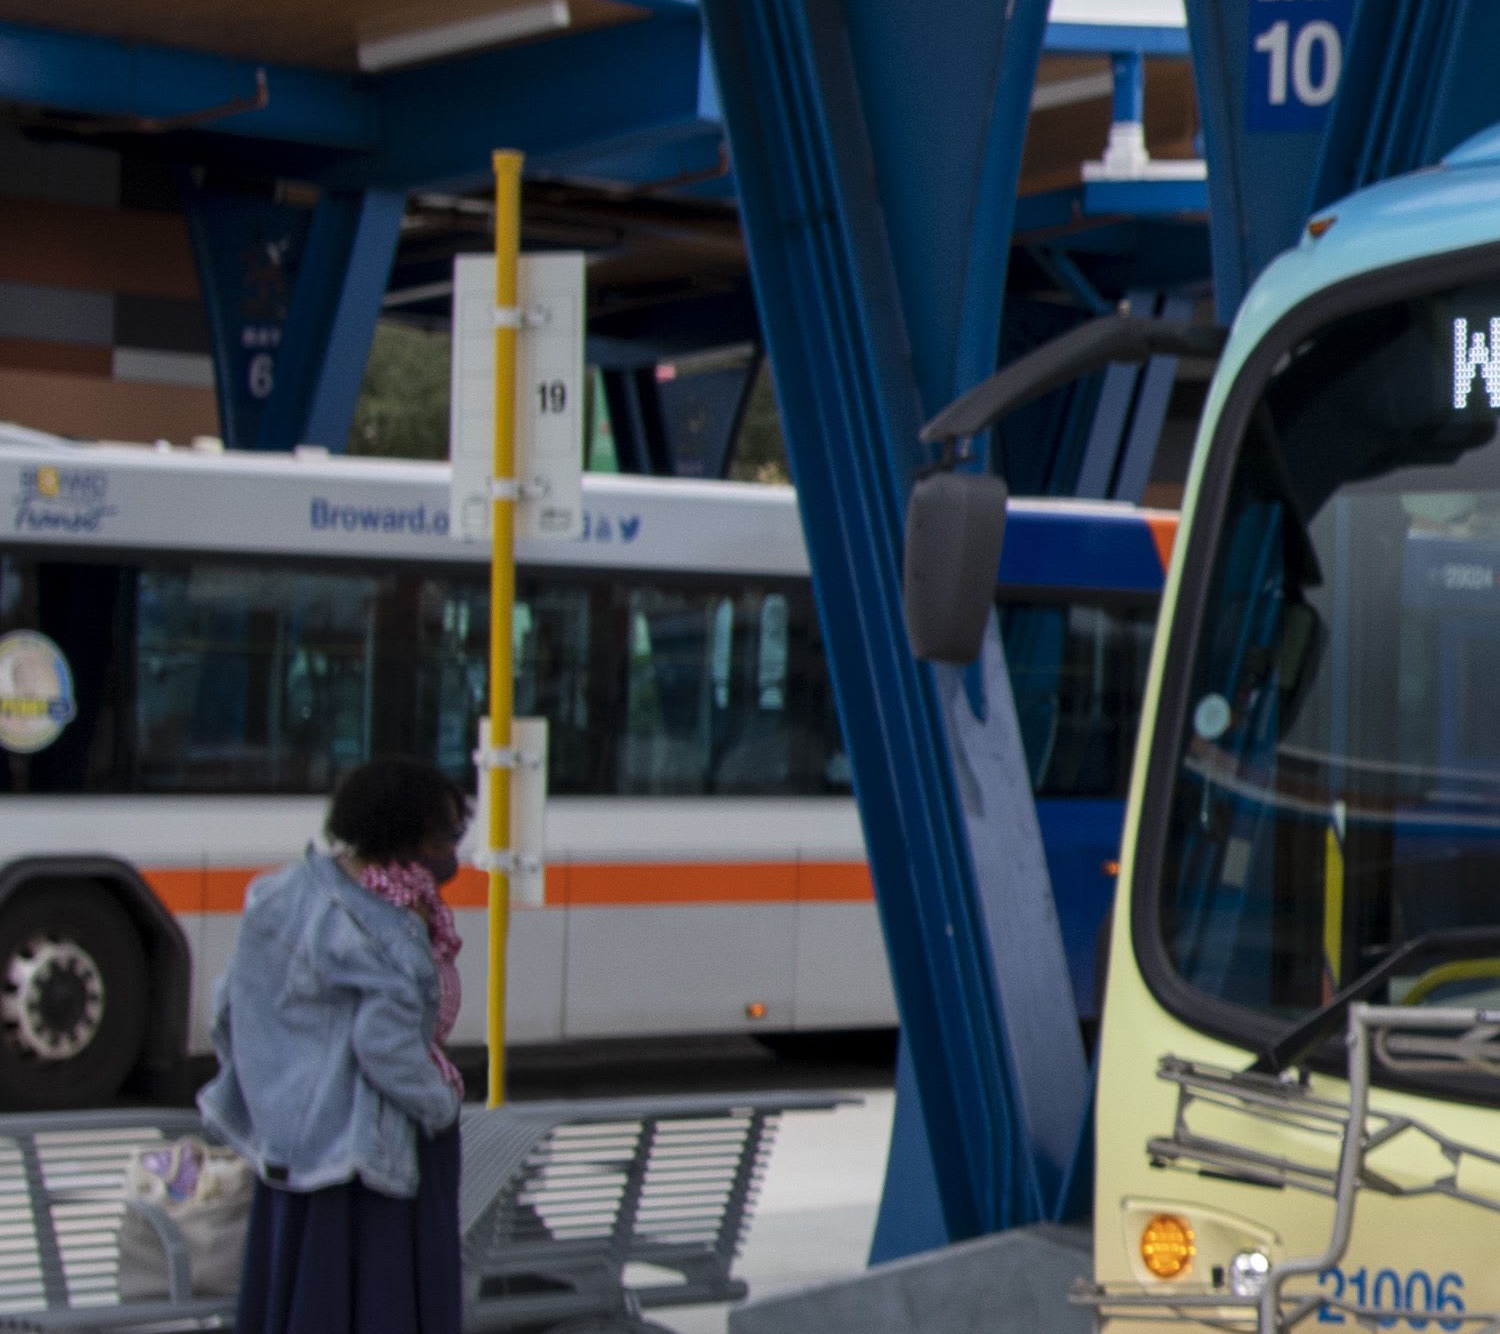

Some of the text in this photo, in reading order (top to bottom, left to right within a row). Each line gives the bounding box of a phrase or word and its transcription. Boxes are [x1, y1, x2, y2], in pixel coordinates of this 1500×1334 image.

[1254, 19, 1342, 106] 10
[538, 380, 567, 413] 19
[309, 496, 451, 535] Broward.o
[1317, 1267, 1466, 1333] 21006
